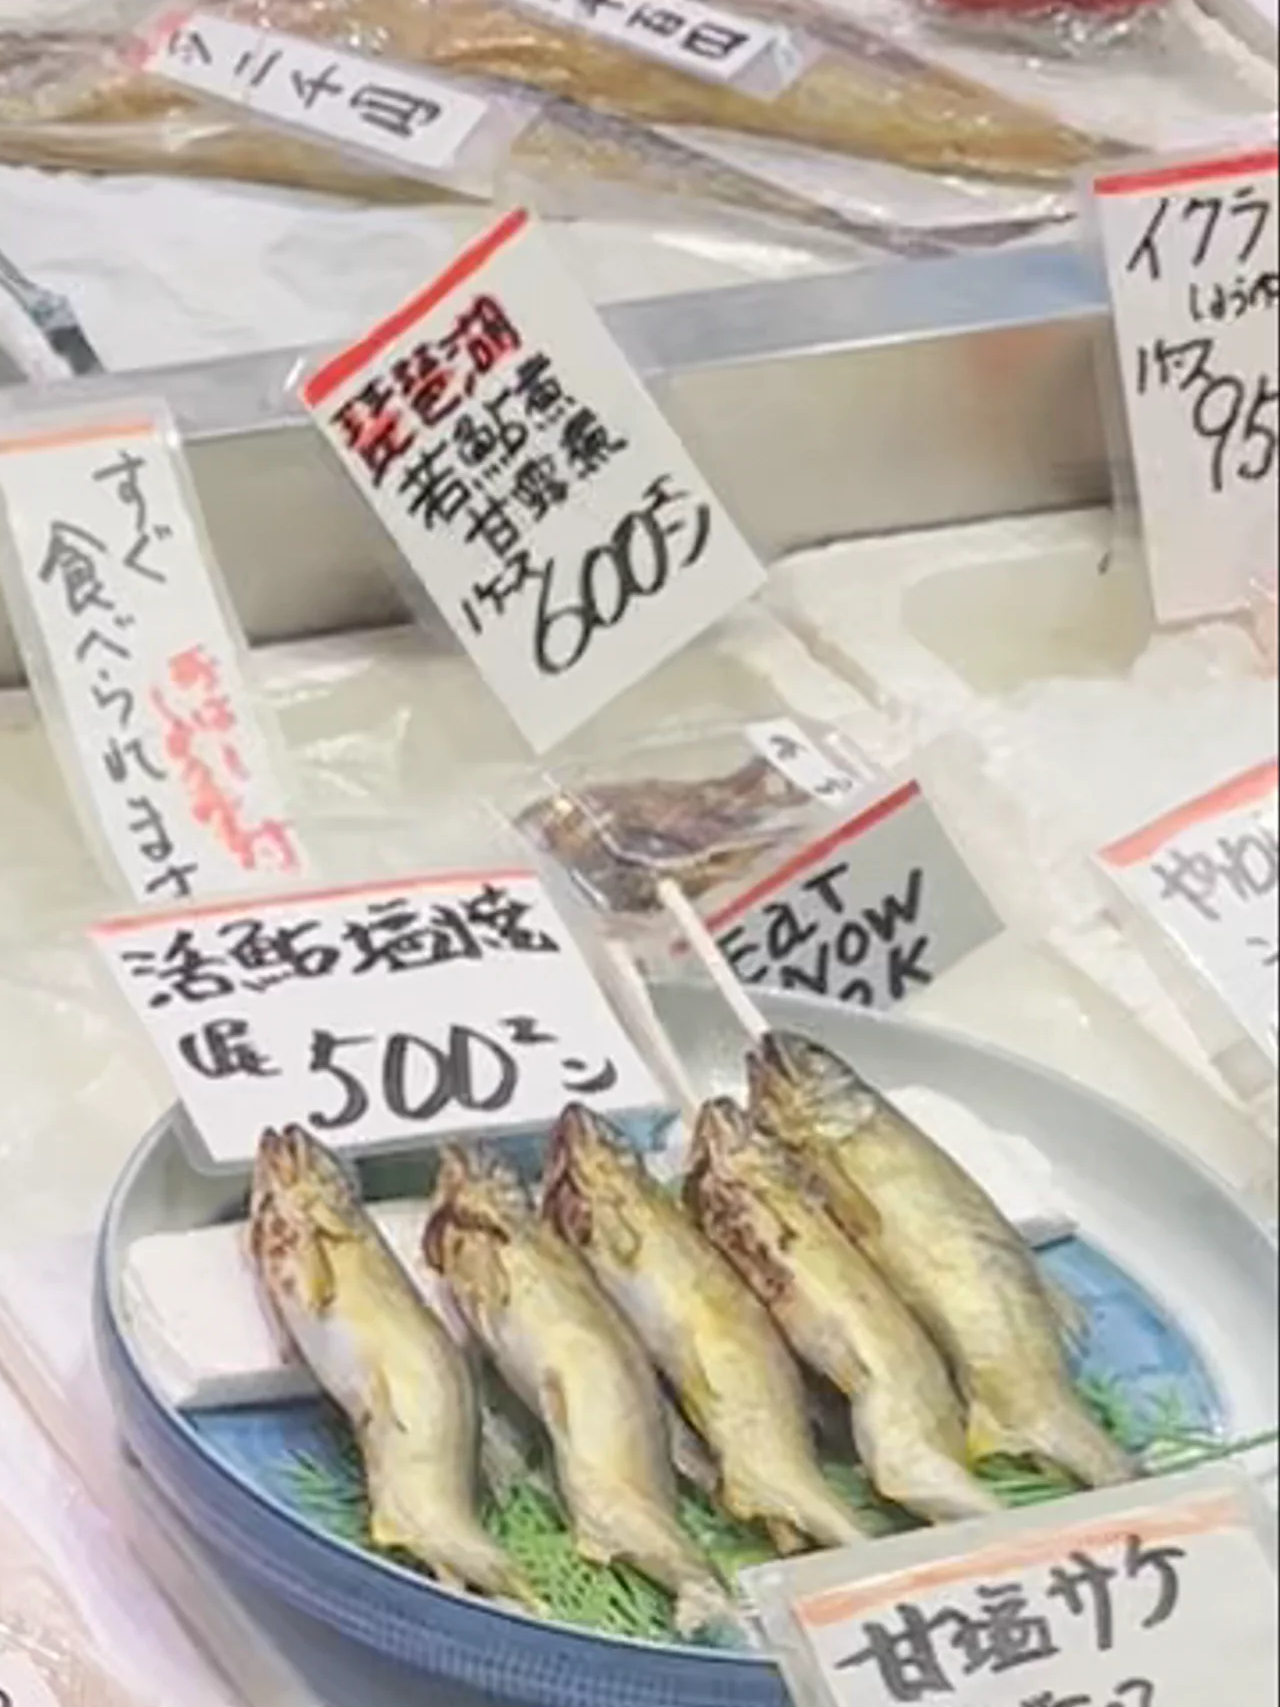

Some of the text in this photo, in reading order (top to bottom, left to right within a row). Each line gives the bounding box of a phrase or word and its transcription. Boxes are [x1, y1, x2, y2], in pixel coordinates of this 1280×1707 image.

[94, 449, 166, 585] すぐ
[40, 518, 198, 898] 食べられます
[835, 1533, 1187, 1703] 甘塩サケ
